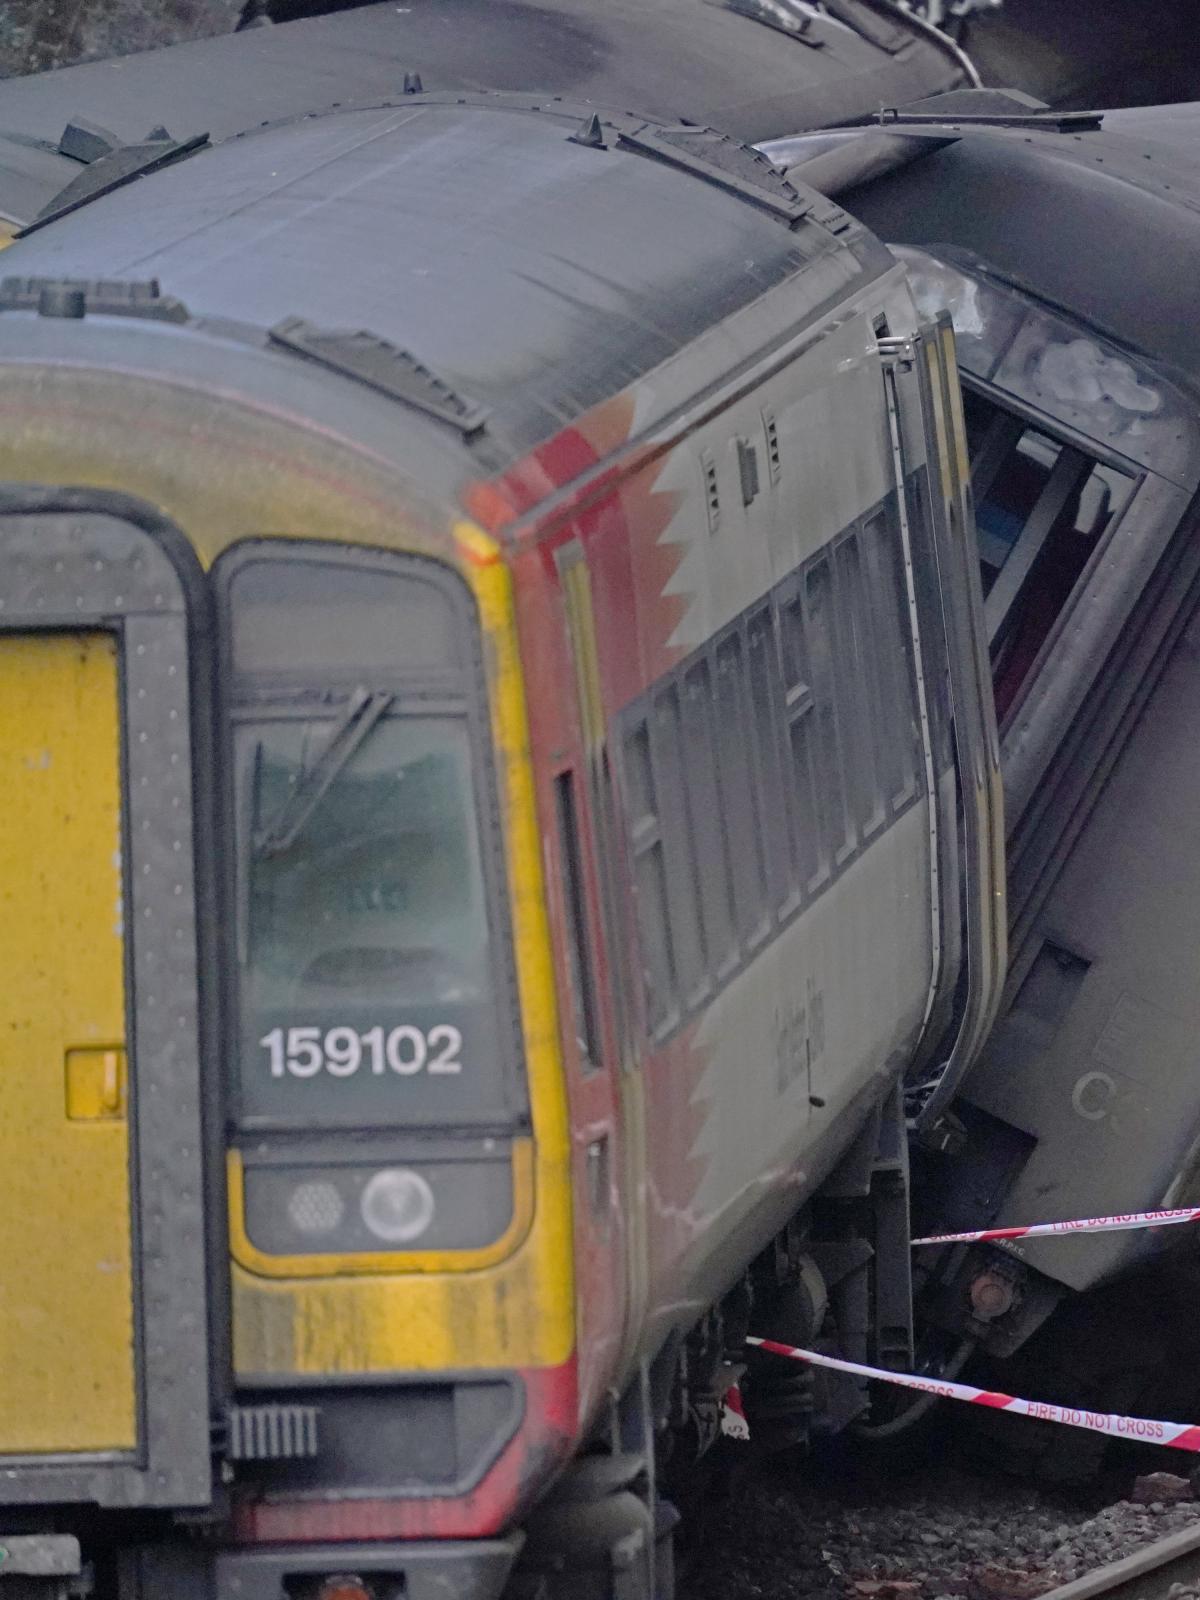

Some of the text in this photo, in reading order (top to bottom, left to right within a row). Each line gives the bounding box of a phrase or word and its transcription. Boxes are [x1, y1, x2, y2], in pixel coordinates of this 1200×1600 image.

[259, 1024, 463, 1077] 159102
[1027, 1402, 1164, 1437] FIRE DO NOT CROSS
